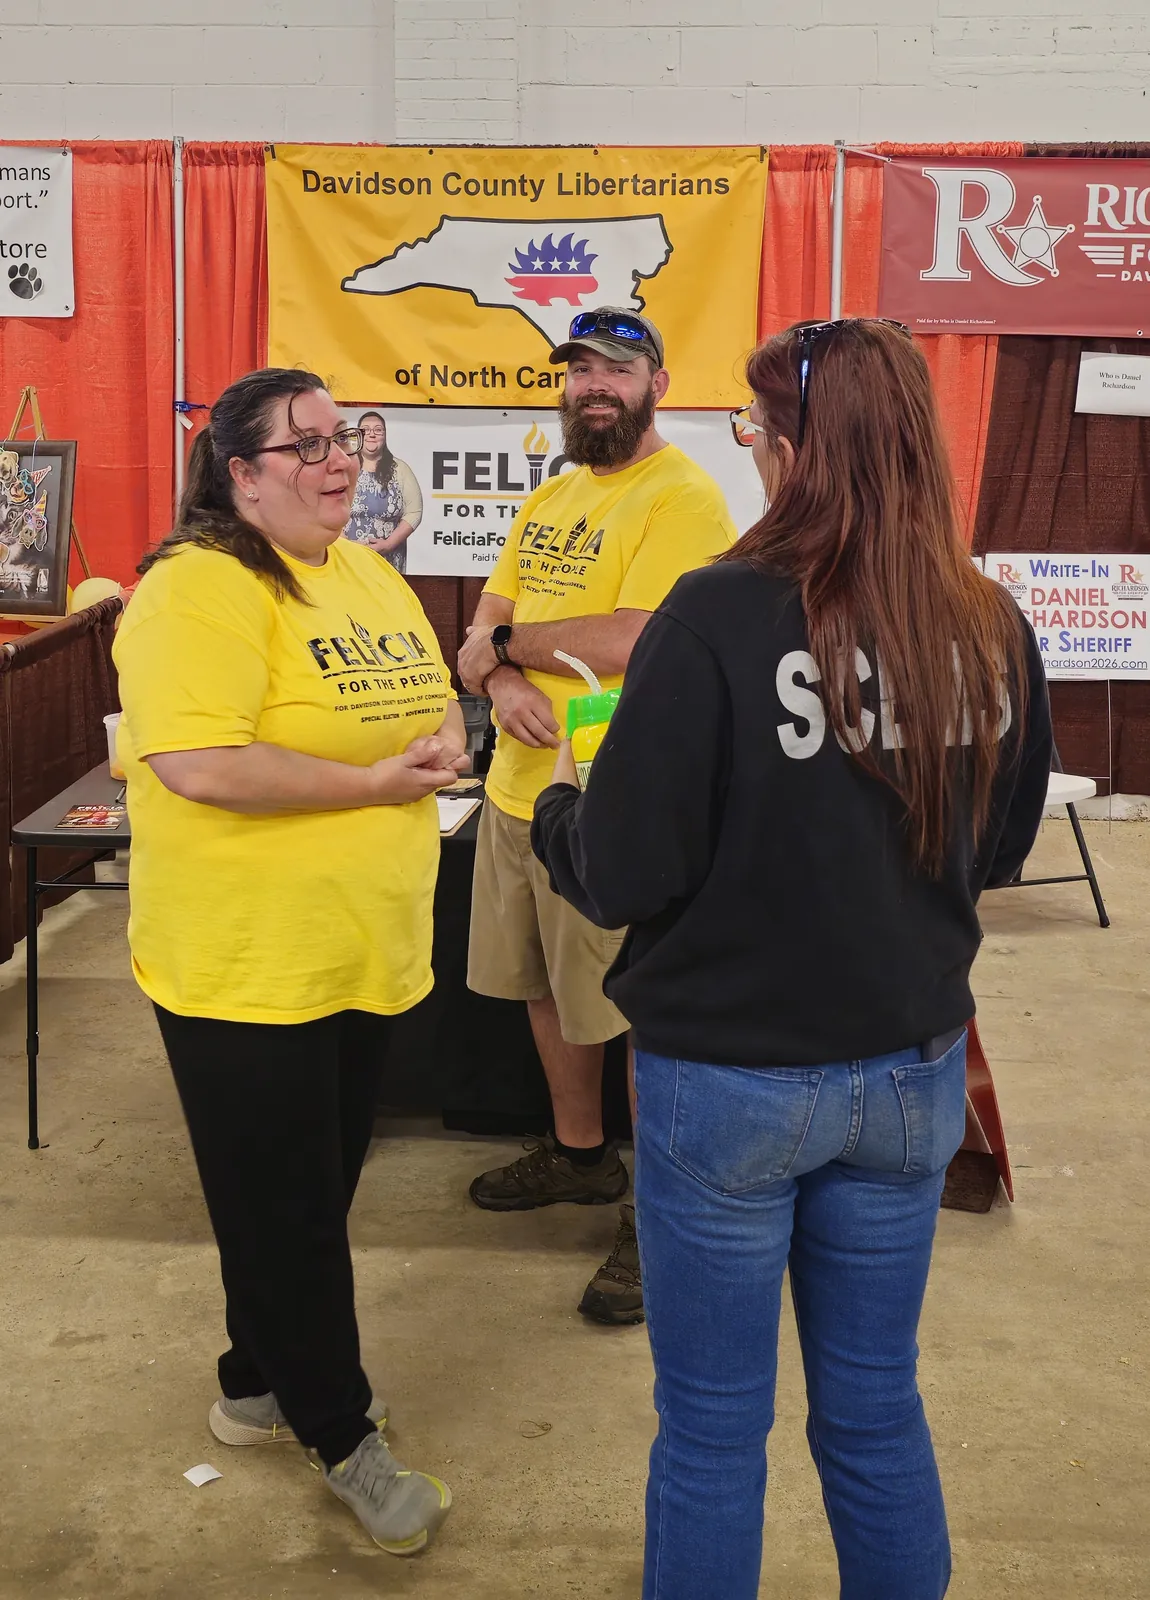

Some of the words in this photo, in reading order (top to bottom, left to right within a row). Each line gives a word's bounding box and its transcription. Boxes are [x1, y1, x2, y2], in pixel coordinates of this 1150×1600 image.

[302, 169, 432, 196] Davidson
[442, 172, 545, 202] County
[557, 171, 730, 196] Libertarians
[395, 363, 422, 386] of
[430, 365, 506, 388] North
[1099, 371, 1114, 379] Who
[1121, 373, 1142, 381] Daniel
[1102, 381, 1136, 390] Richardson
[443, 504, 486, 518] FOR
[433, 531, 506, 547] FeliciaFo
[472, 553, 490, 562] Paid
[1111, 584, 1149, 592] RICHARDSON
[1031, 587, 1110, 607] DANIEL
[1021, 609, 1147, 629] HARDSON
[1058, 630, 1132, 653] SHERIFF
[306, 628, 432, 672] FELICIA
[337, 679, 373, 695] FOR
[373, 678, 396, 690] THE
[350, 701, 381, 710] DAVIDSON
[397, 697, 415, 705] BOARD
[361, 715, 382, 723] SPECIAL
[405, 707, 431, 717] NOVEMBER
